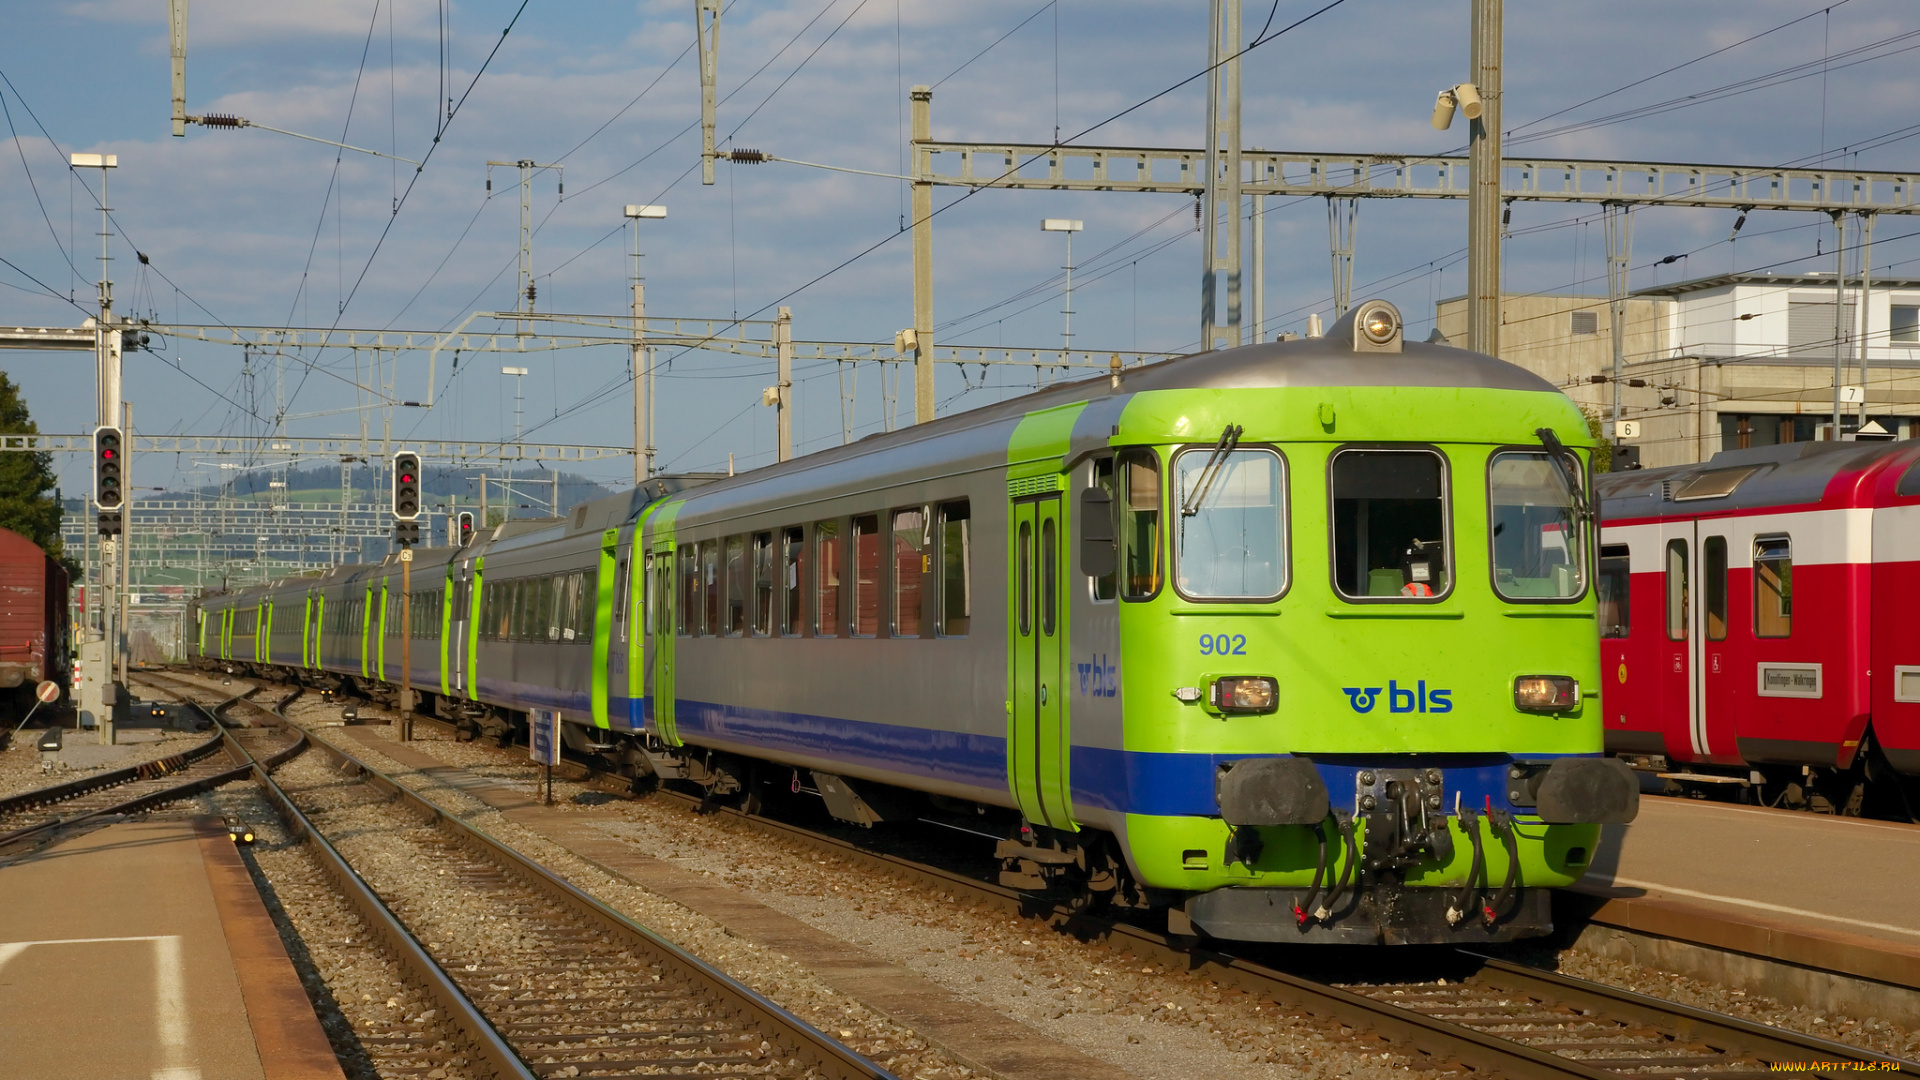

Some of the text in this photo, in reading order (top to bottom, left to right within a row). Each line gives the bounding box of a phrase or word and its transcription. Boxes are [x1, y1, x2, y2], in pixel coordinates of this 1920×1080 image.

[1849, 388, 1856, 400] 7
[1625, 423, 1631, 435] 6
[923, 504, 930, 545] 2
[1199, 633, 1247, 656] 902
[1092, 653, 1116, 698] bls
[1388, 679, 1453, 714] bls
